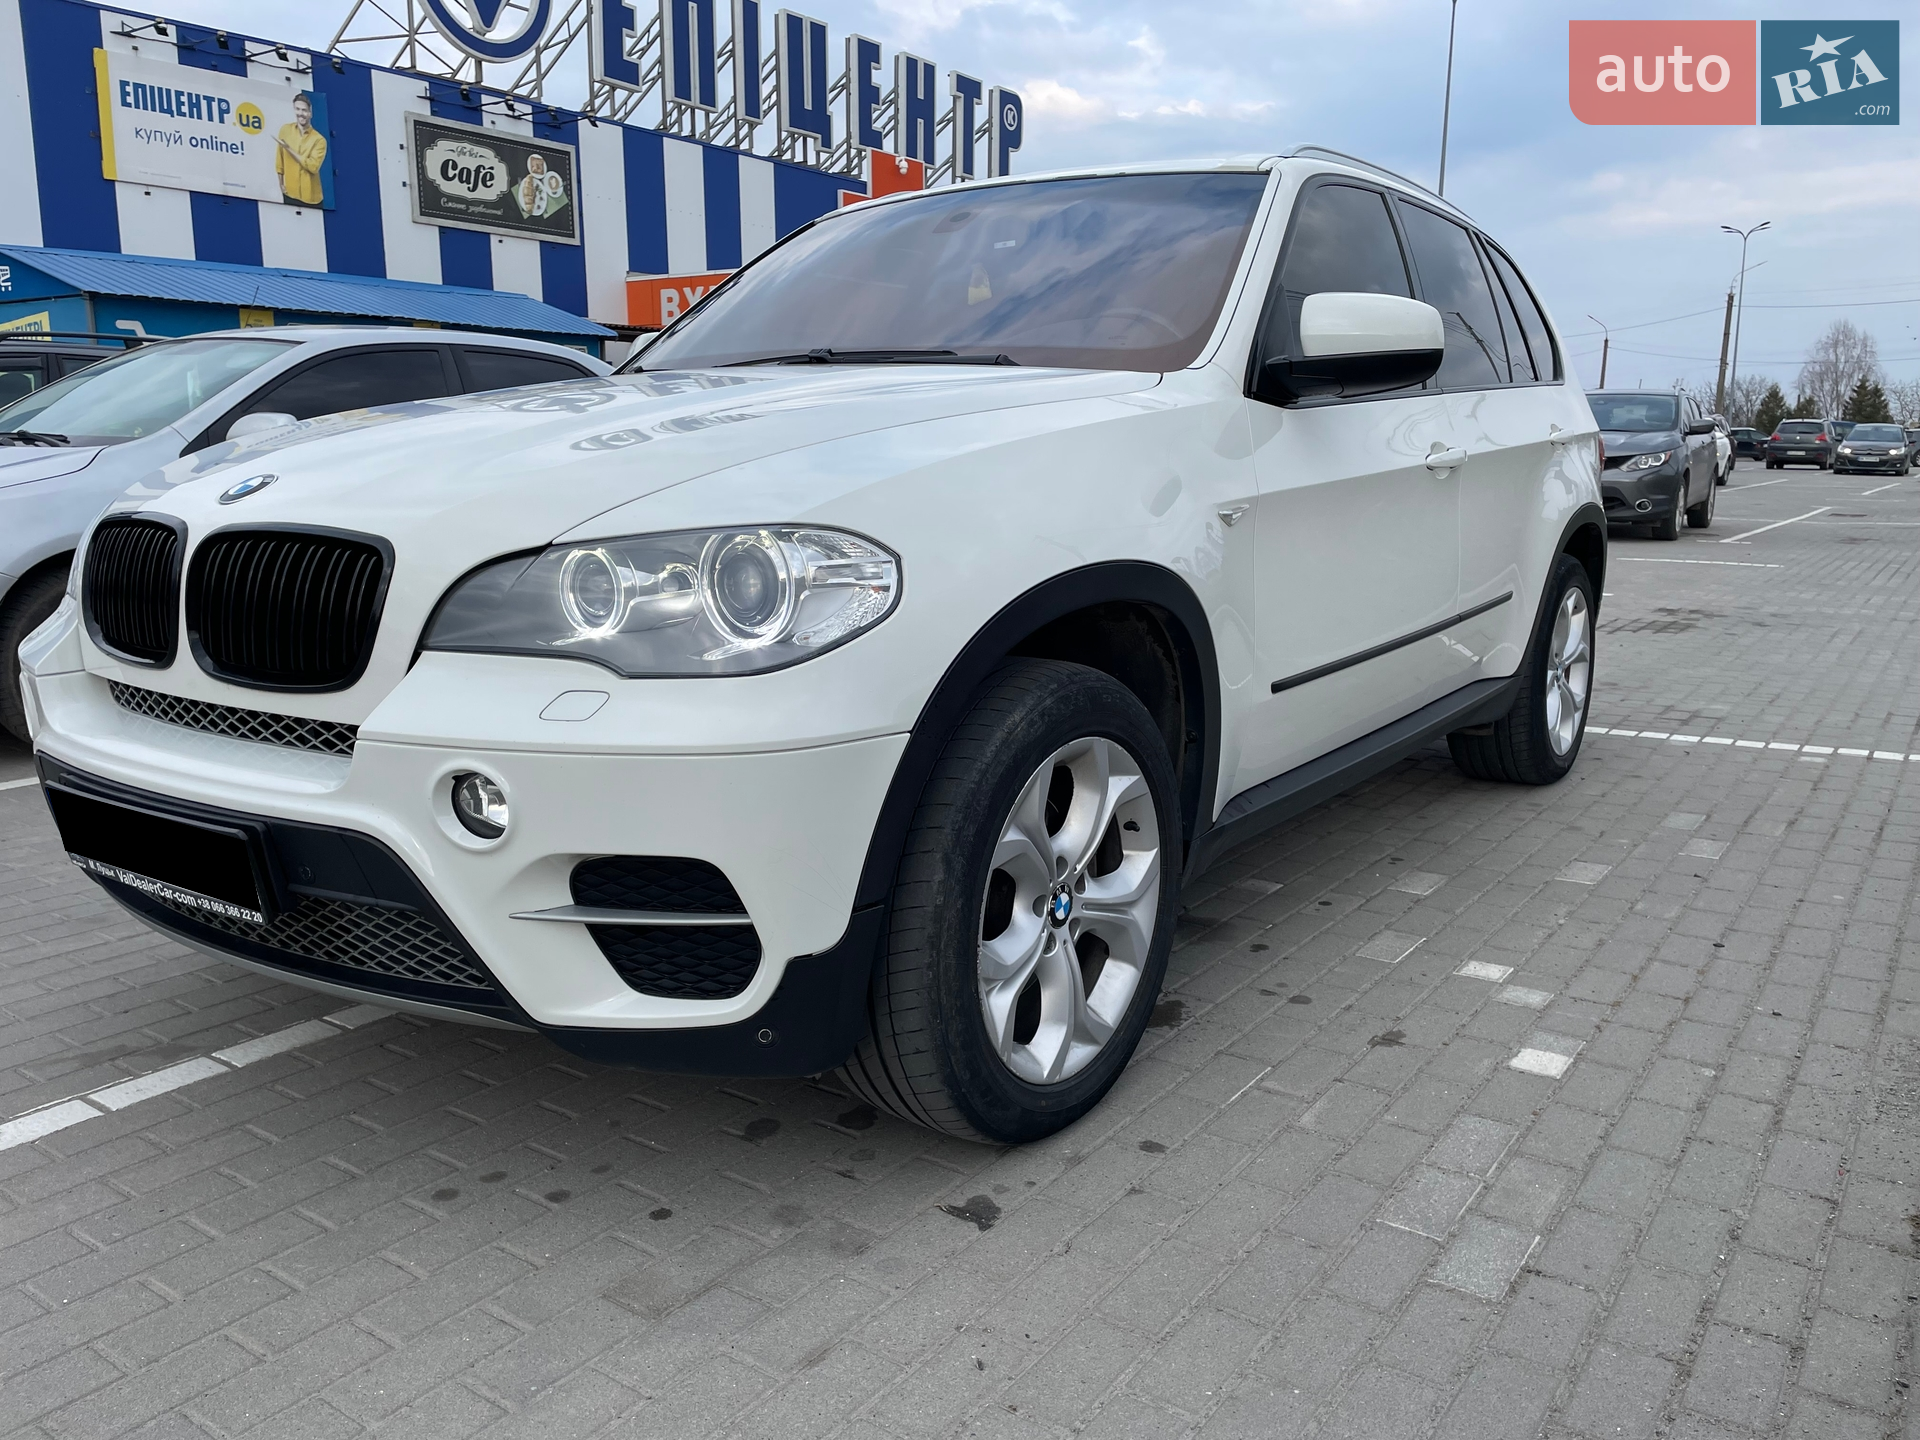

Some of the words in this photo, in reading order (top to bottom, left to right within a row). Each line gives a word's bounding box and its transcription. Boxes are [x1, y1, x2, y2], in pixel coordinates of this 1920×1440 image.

[134, 127, 183, 148] купуй
[189, 135, 245, 155] online!
[440, 158, 495, 193] Café
[240, 909, 252, 920] 22
[251, 911, 263, 923] 20
